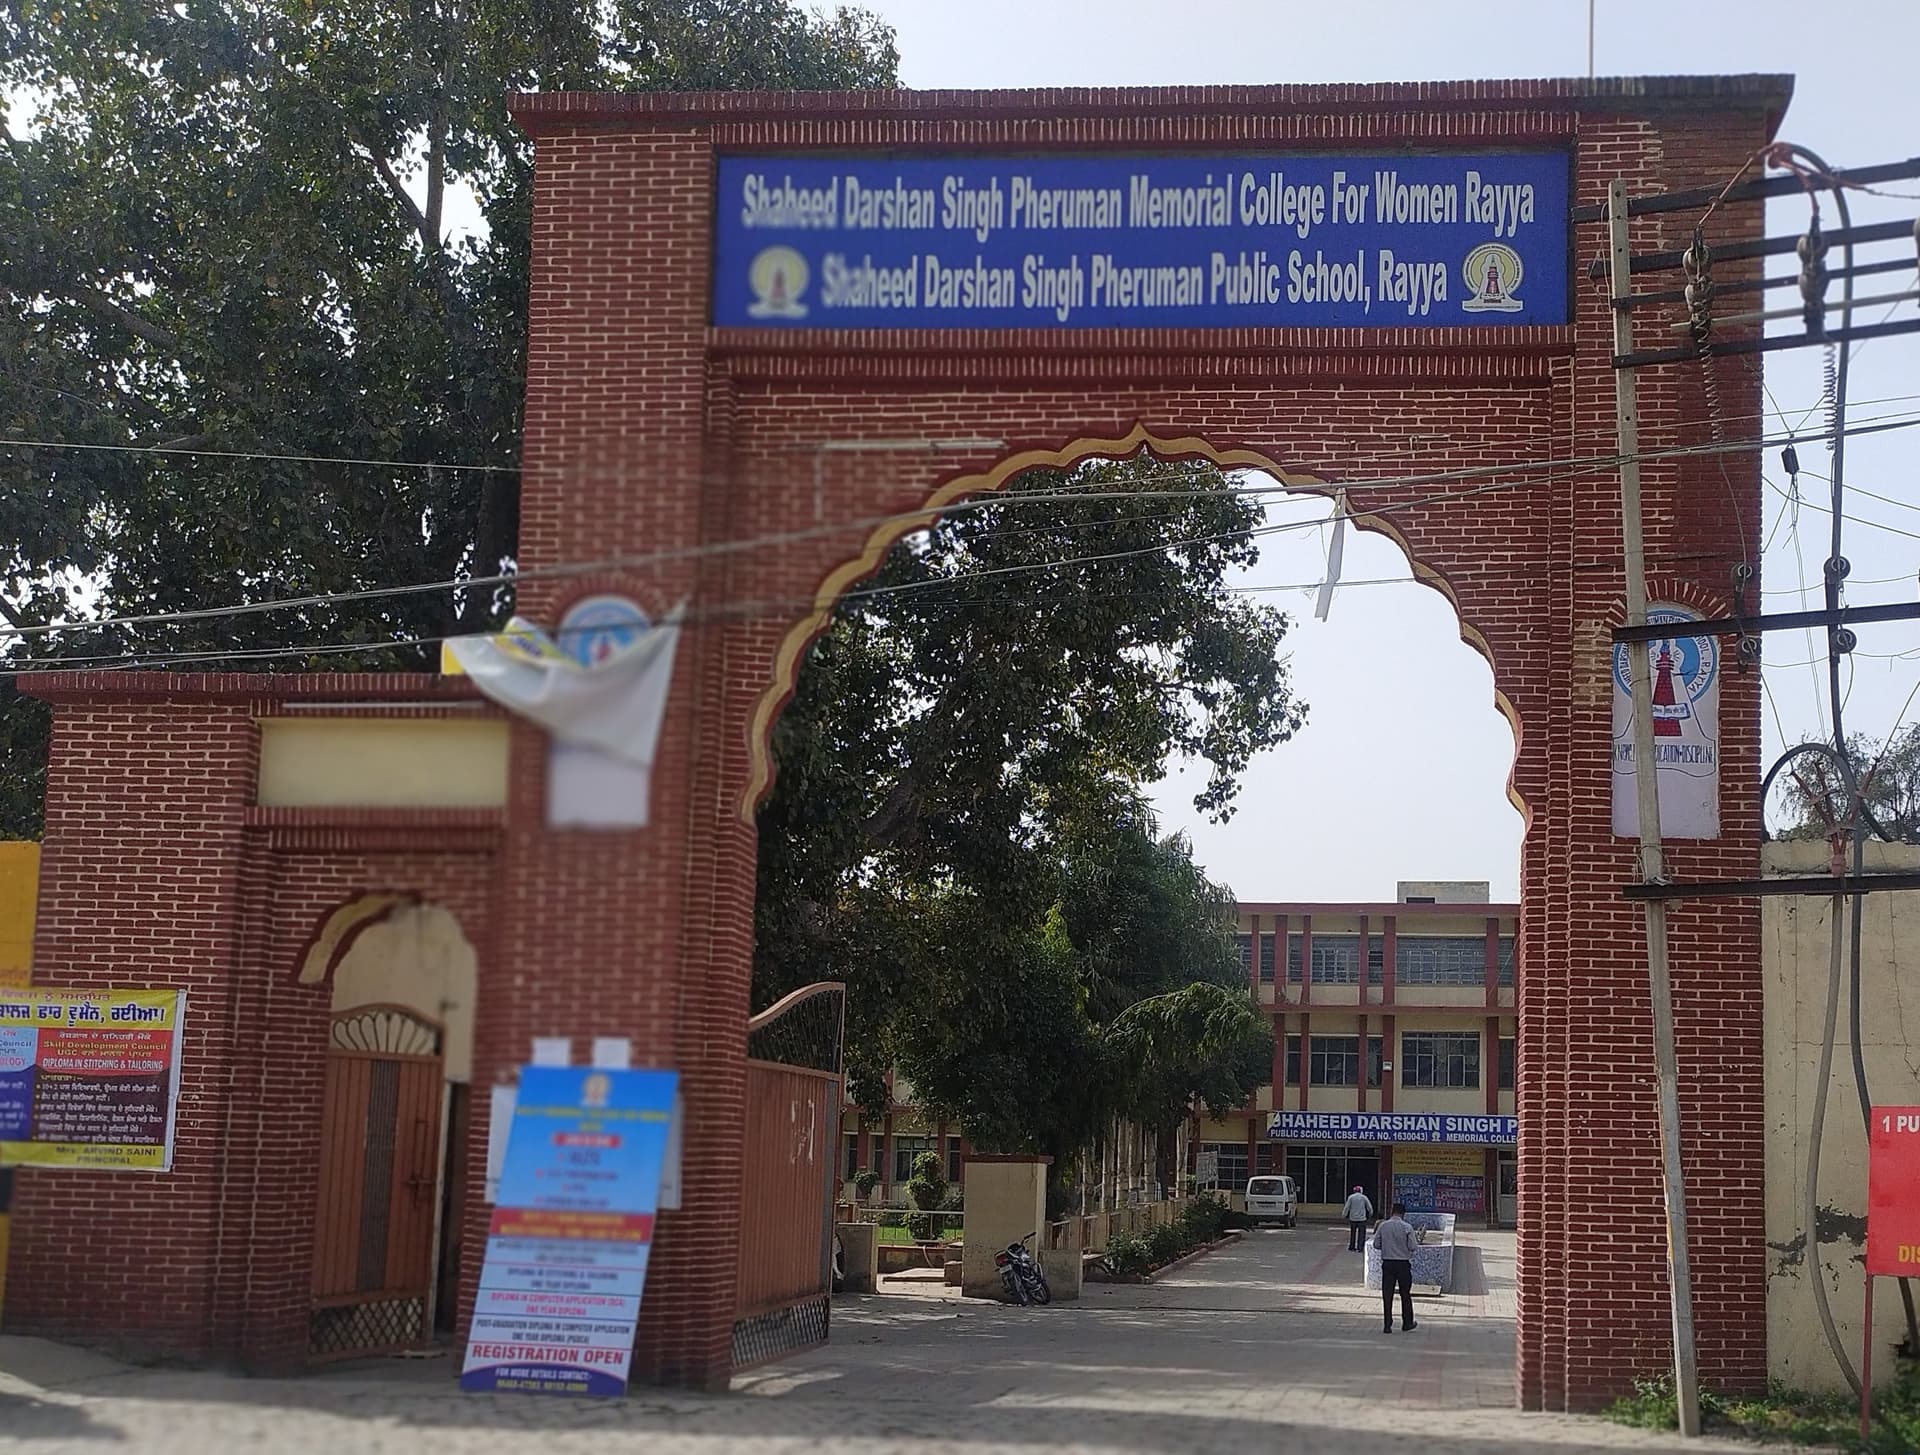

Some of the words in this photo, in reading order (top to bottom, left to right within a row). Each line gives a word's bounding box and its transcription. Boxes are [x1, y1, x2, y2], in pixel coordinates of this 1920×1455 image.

[742, 174, 838, 227] Shaheed
[844, 176, 935, 229] Darshan
[942, 176, 1002, 243] Singh
[1011, 176, 1122, 229] Pheruman
[1129, 174, 1232, 228] Memorial
[1240, 172, 1325, 239] College
[1332, 171, 1370, 225] For
[1374, 171, 1457, 224] Women
[1465, 171, 1534, 237] Rayya
[822, 253, 917, 308] Shaheed
[924, 255, 1015, 308] Darshan
[1022, 254, 1083, 322] Singh
[1091, 254, 1203, 307] Pheruman
[1211, 252, 1280, 306] Public
[1287, 249, 1371, 315] School,
[1378, 249, 1447, 316] Rayya
[67, 1042, 128, 1050] Development
[43, 1058, 73, 1067] DIPLOMA
[74, 1059, 82, 1068] IN
[83, 1059, 118, 1069] STITCHING
[128, 1060, 163, 1070] TAILORING
[1357, 1115, 1440, 1130] DARSHAN
[1446, 1117, 1501, 1133] SINGH
[1882, 1115, 1890, 1133] 1
[1270, 1128, 1299, 1138] PUBLIC
[1300, 1129, 1332, 1139] SCHOOL
[1334, 1130, 1357, 1140] (CBSE
[1359, 1131, 1375, 1140] AFF.
[1377, 1131, 1391, 1140] NO.
[1446, 1133, 1489, 1143] MEMORIAL
[1490, 1134, 1518, 1144] COLLE
[127, 1148, 156, 1156] SAINI
[472, 1345, 578, 1362] REGISTRATION
[583, 1350, 624, 1364] OPEN
